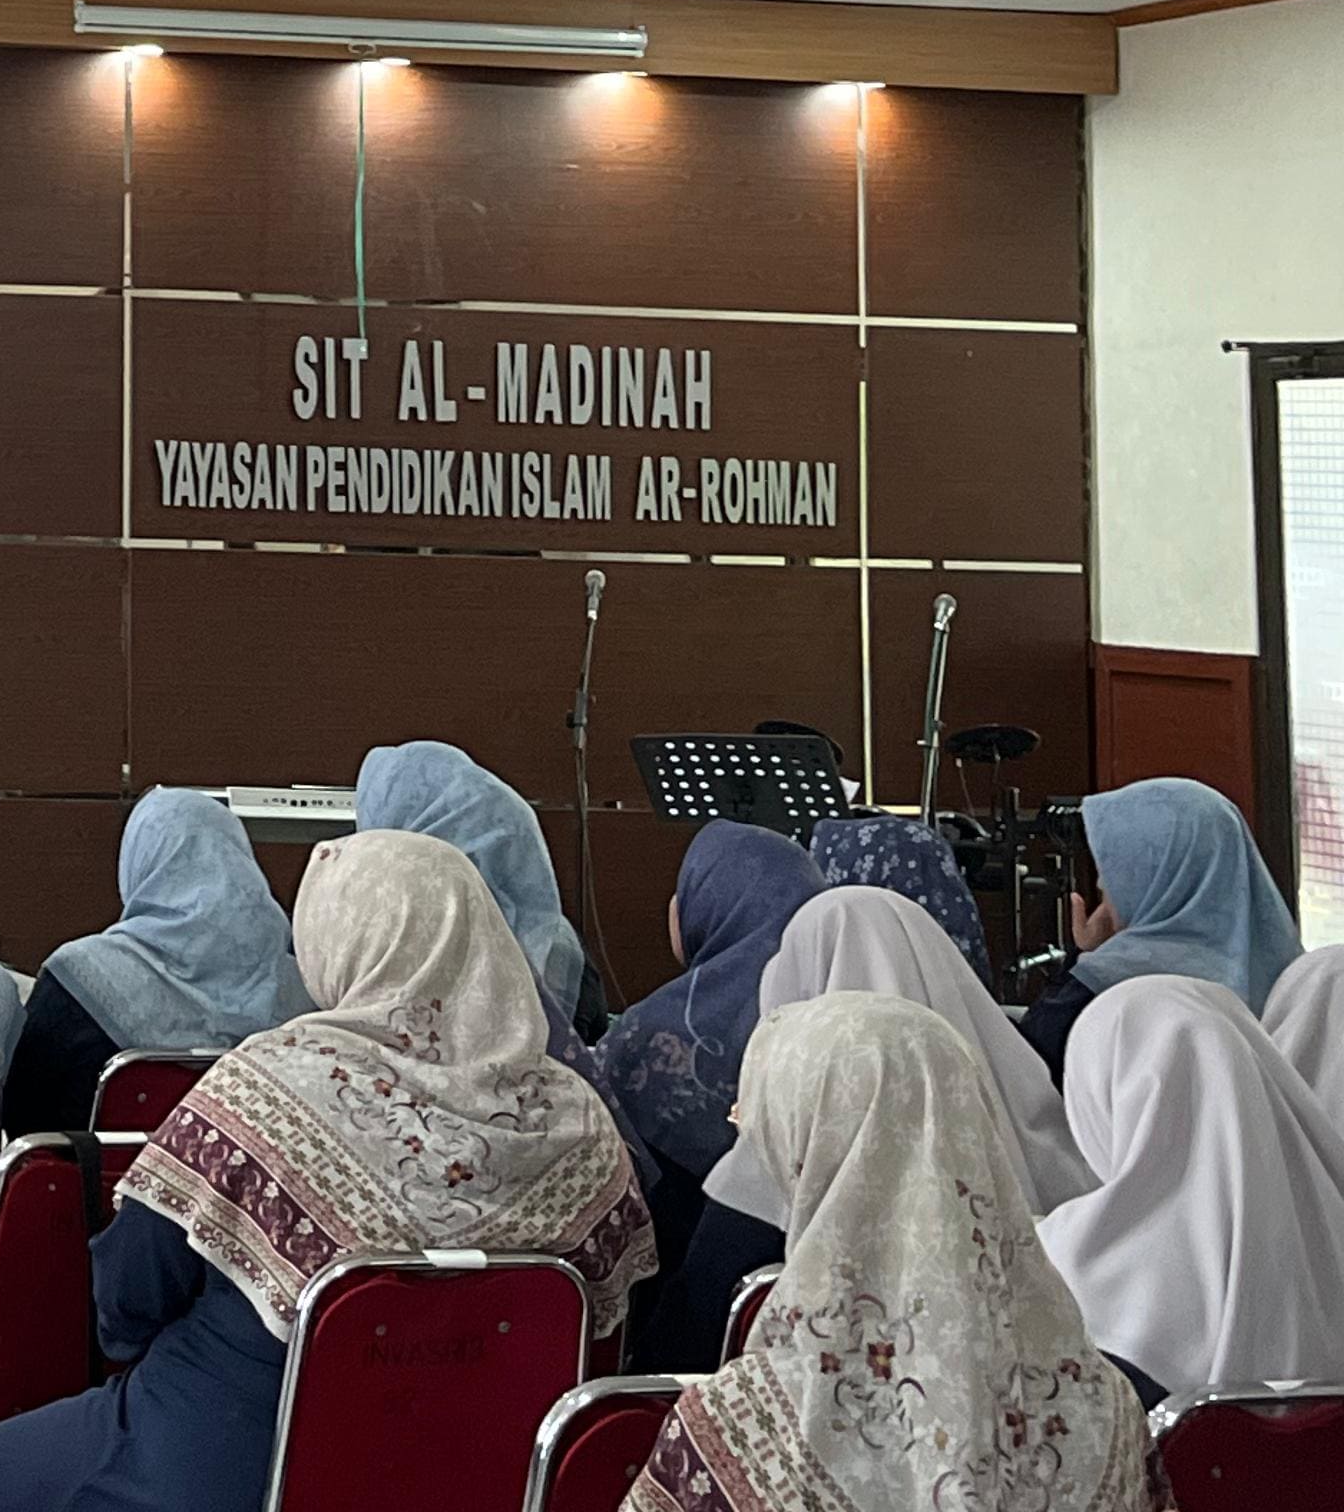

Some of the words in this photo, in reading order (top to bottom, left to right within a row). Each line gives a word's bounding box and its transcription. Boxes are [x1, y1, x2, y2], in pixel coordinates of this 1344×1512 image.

[293, 335, 368, 420] SIT
[398, 339, 711, 430] AL-MADINAH
[155, 439, 298, 511] YAYASAN
[306, 445, 503, 517] PENDIDIKAN
[511, 450, 611, 520] ISLAM
[635, 455, 837, 527] AR-ROHMAN
